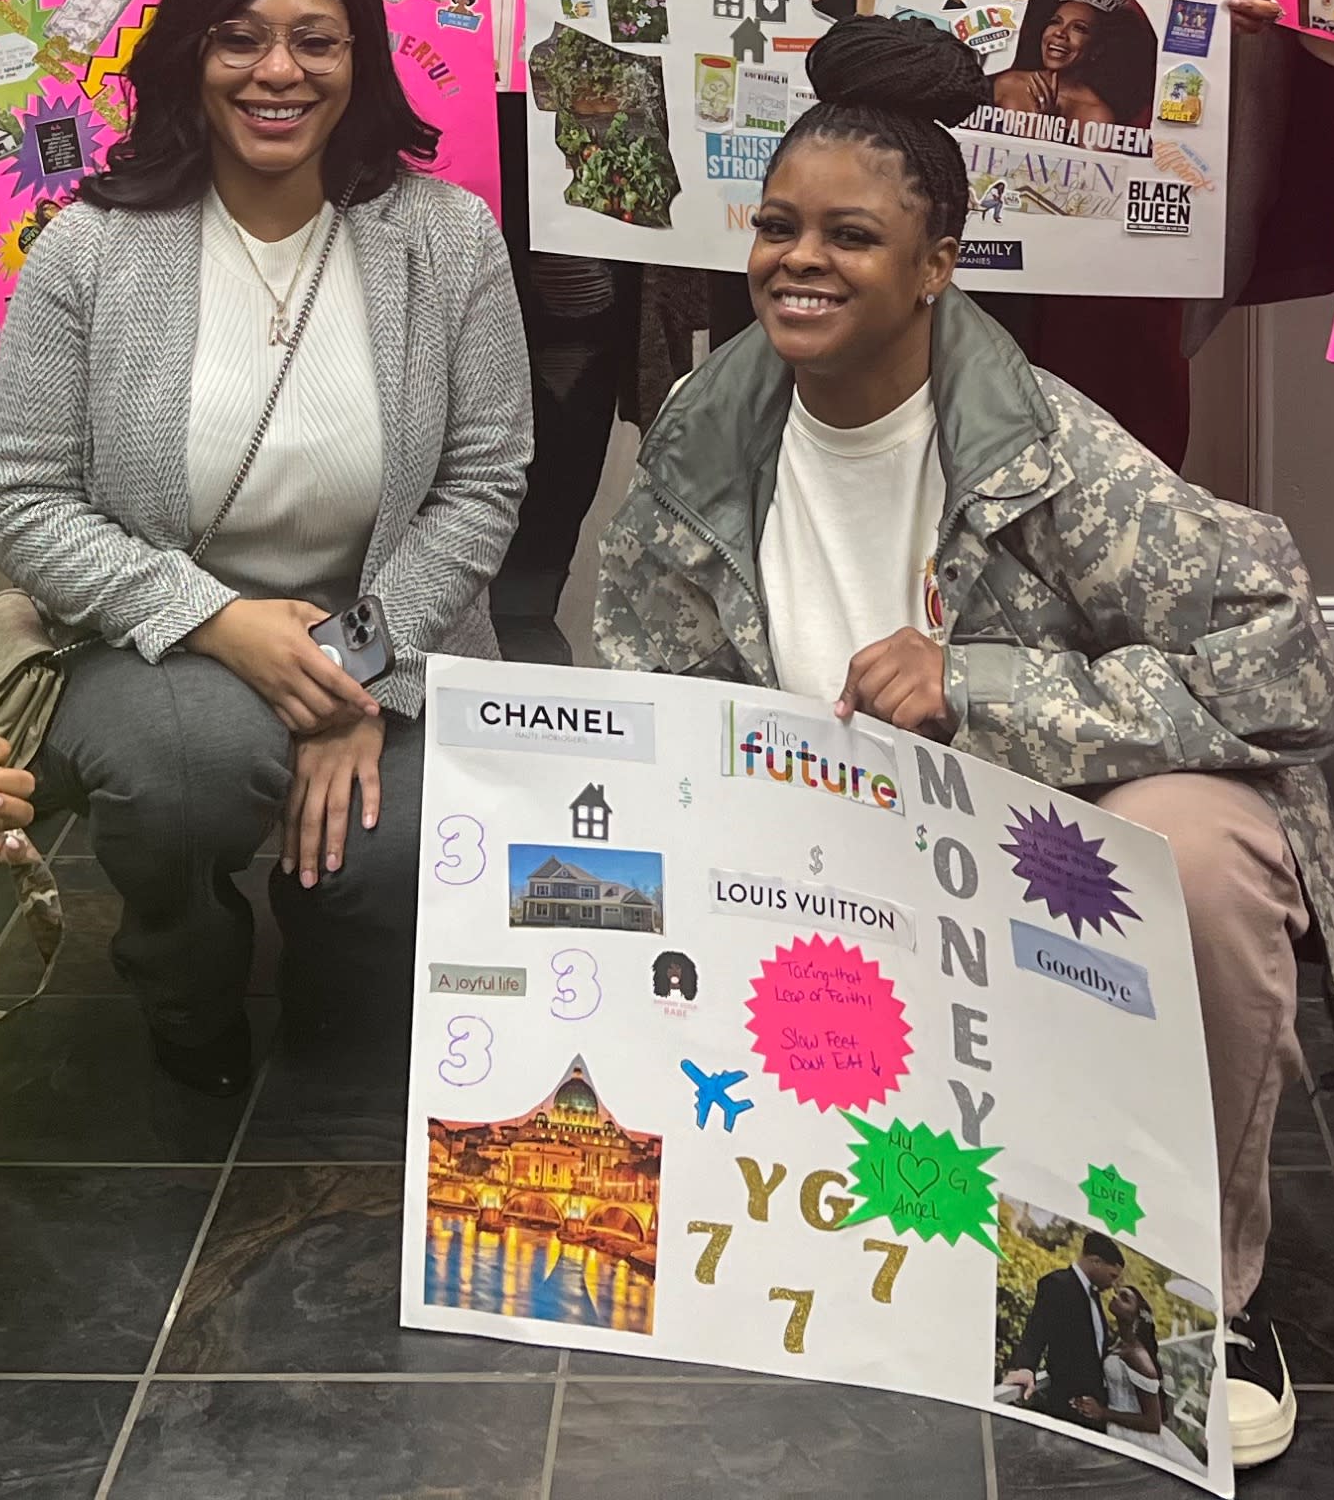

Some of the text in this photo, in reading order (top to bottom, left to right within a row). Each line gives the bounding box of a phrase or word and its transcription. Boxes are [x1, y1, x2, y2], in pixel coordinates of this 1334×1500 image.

[969, 30, 1010, 46] EXCELLENCE
[1127, 201, 1191, 225] QUEEN
[1128, 180, 1193, 204] BLACK
[958, 241, 1013, 256] FAMILY
[478, 701, 627, 736] CHANEL
[759, 713, 799, 748] The
[739, 730, 899, 809] future
[434, 814, 487, 886] 3
[716, 879, 895, 932] LOUIS VUITTON
[914, 744, 996, 1147] MONEY
[438, 974, 520, 993] A joyful life
[550, 947, 602, 1020] 3
[1035, 948, 1132, 1003] Goodbye
[438, 1015, 493, 1086] 3
[781, 1027, 821, 1051] Slow
[1090, 1182, 1126, 1207] LOVE
[686, 1220, 733, 1285] 7
[863, 1237, 909, 1304] 7
[769, 1286, 815, 1354] 7
